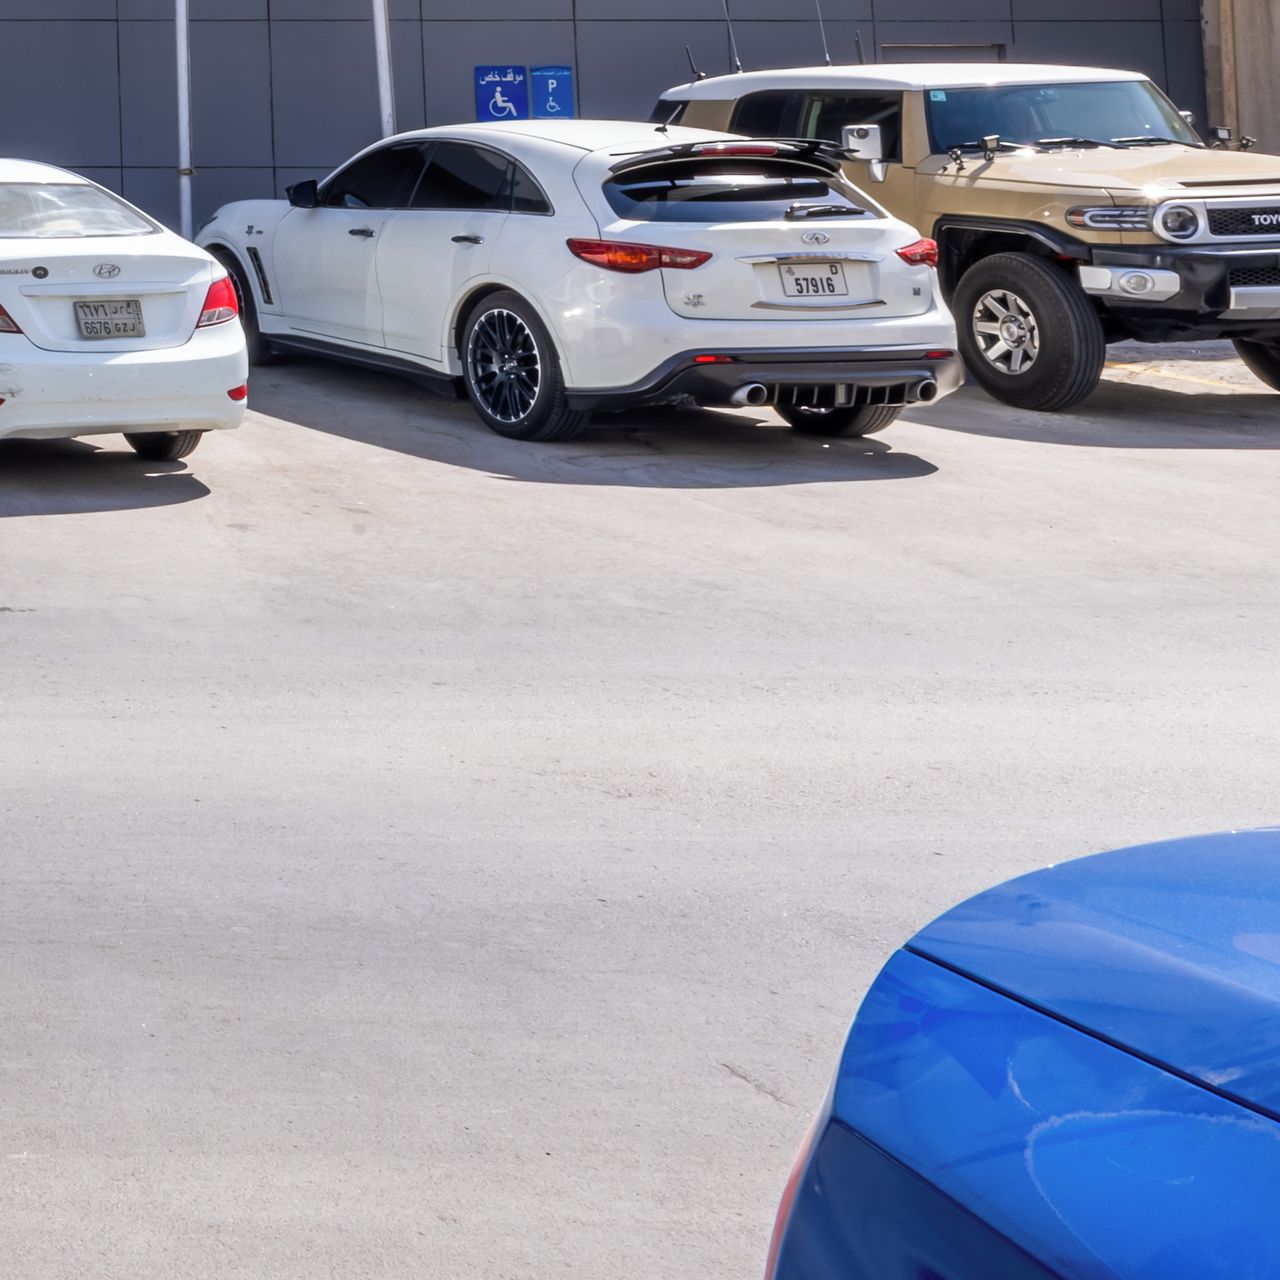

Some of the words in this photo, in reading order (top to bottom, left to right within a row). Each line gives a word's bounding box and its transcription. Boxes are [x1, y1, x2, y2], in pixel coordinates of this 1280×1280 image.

[548, 79, 557, 92] P
[1251, 214, 1280, 225] TOY
[794, 276, 835, 294] 57916
[84, 321, 111, 335] 6676
[114, 323, 136, 332] GZJ
